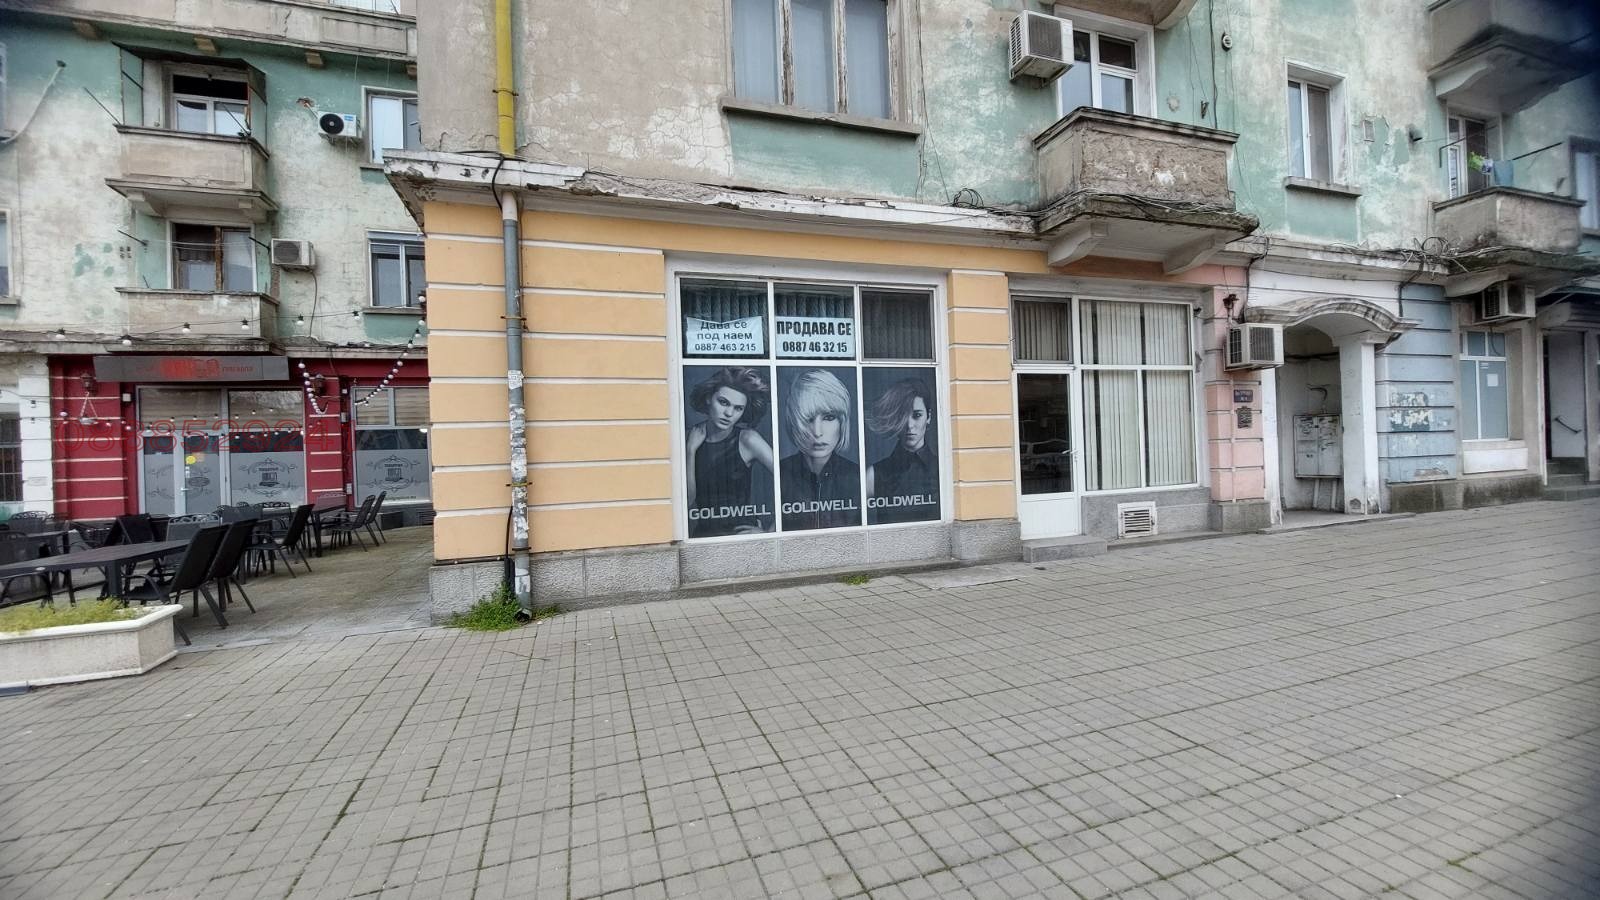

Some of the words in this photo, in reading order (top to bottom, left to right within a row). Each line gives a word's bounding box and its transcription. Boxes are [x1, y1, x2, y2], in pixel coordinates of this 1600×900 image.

[700, 321, 731, 330] Дава
[734, 321, 748, 329] се
[776, 321, 835, 337] ПРОДАВА
[837, 322, 851, 336] СЕ
[697, 332, 720, 341] под
[723, 332, 753, 340] наем
[695, 343, 717, 351] 0887
[720, 343, 737, 351] 463
[740, 343, 756, 351] 215
[782, 341, 807, 352] 0887
[808, 341, 822, 352] 46
[836, 342, 848, 353] 15
[782, 499, 858, 515] GOLDWELL
[867, 494, 937, 509] GOLDWELL
[688, 504, 772, 520] GOLDWELL
